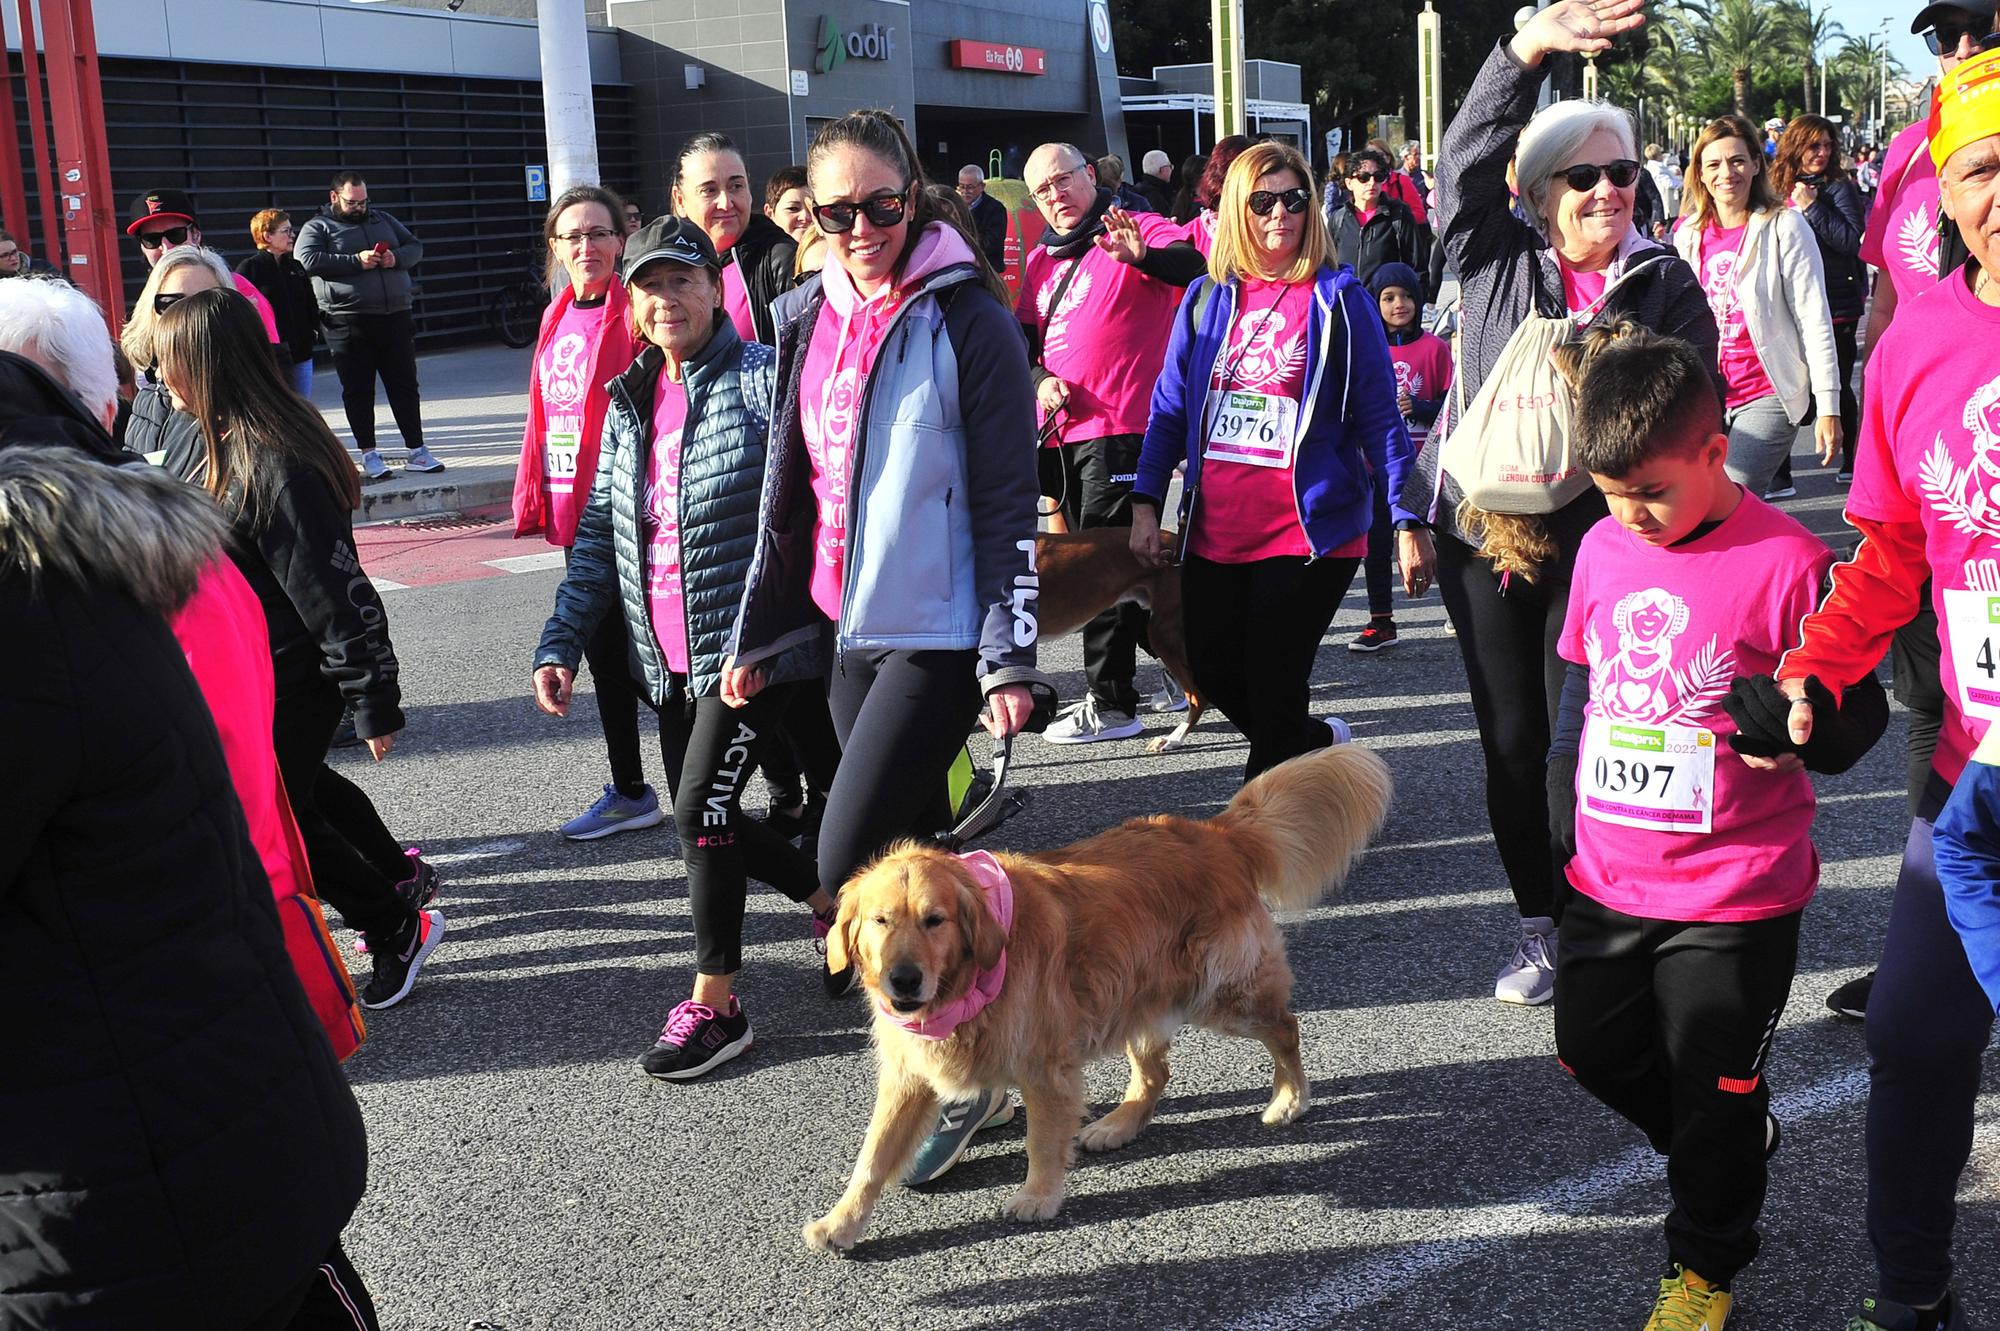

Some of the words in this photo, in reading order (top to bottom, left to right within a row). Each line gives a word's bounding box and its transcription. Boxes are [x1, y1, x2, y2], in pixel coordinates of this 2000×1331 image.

[848, 22, 896, 61] adif
[527, 169, 542, 198] P
[1217, 414, 1275, 442] 3976
[1498, 473, 1530, 483] LLENGUA
[1531, 472, 1563, 483] CULTURA
[1012, 539, 1040, 648] FILA
[1666, 743, 1698, 755] 2022
[703, 721, 757, 827] ACTIVE
[1595, 756, 1675, 798] 0397
[1605, 803, 1628, 814] CONTRA
[1628, 807, 1636, 816] EL
[1662, 812, 1672, 820] DE
[1673, 812, 1696, 821] MAMA
